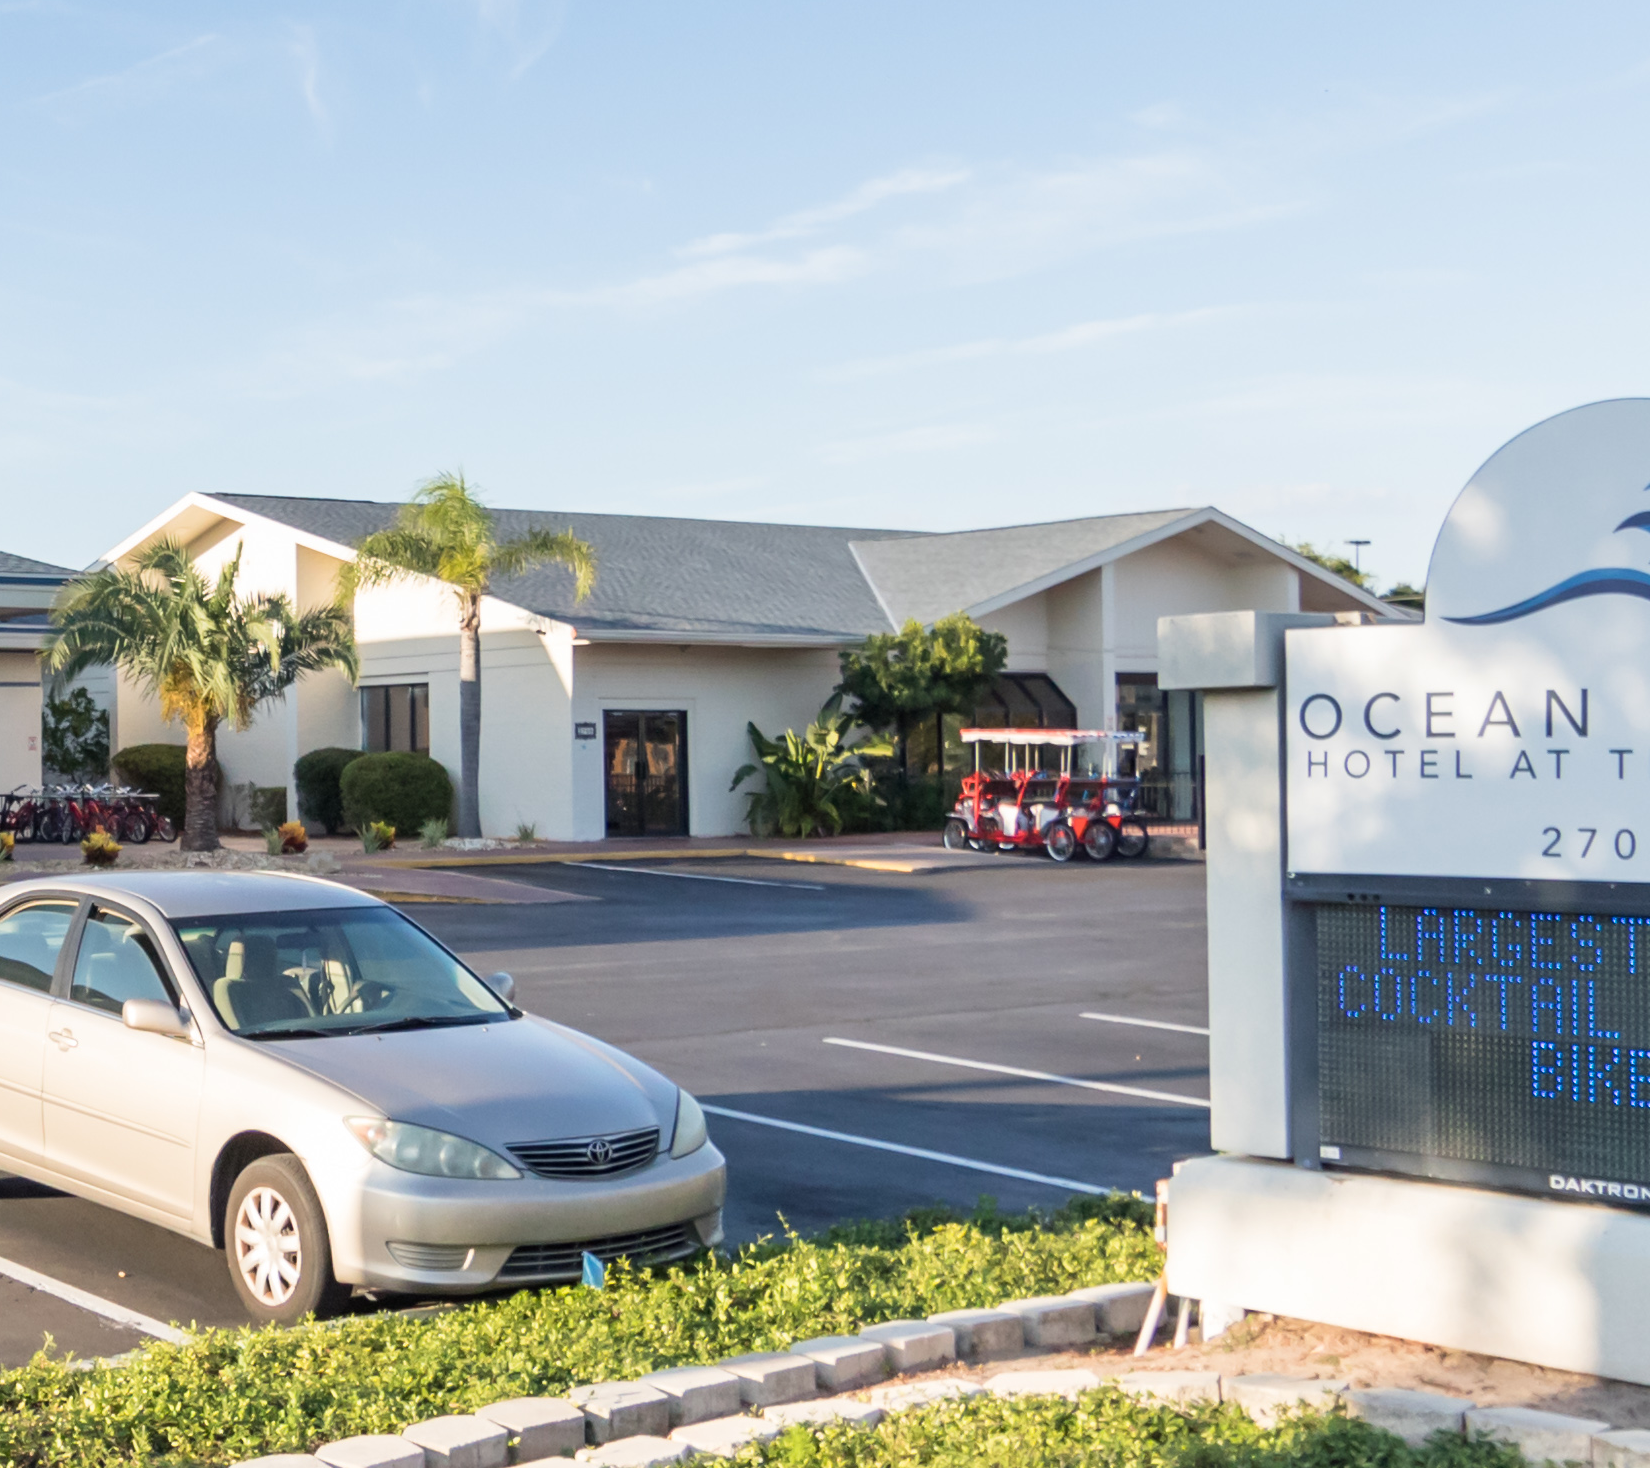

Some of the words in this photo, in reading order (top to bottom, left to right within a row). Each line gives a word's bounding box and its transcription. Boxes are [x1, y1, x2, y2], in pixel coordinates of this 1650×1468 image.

[1298, 688, 1589, 740] OCEAN
[1307, 749, 1473, 779] HOTEL
[1509, 749, 1571, 780] AT
[1338, 964, 1621, 1039] COCKTAIL
